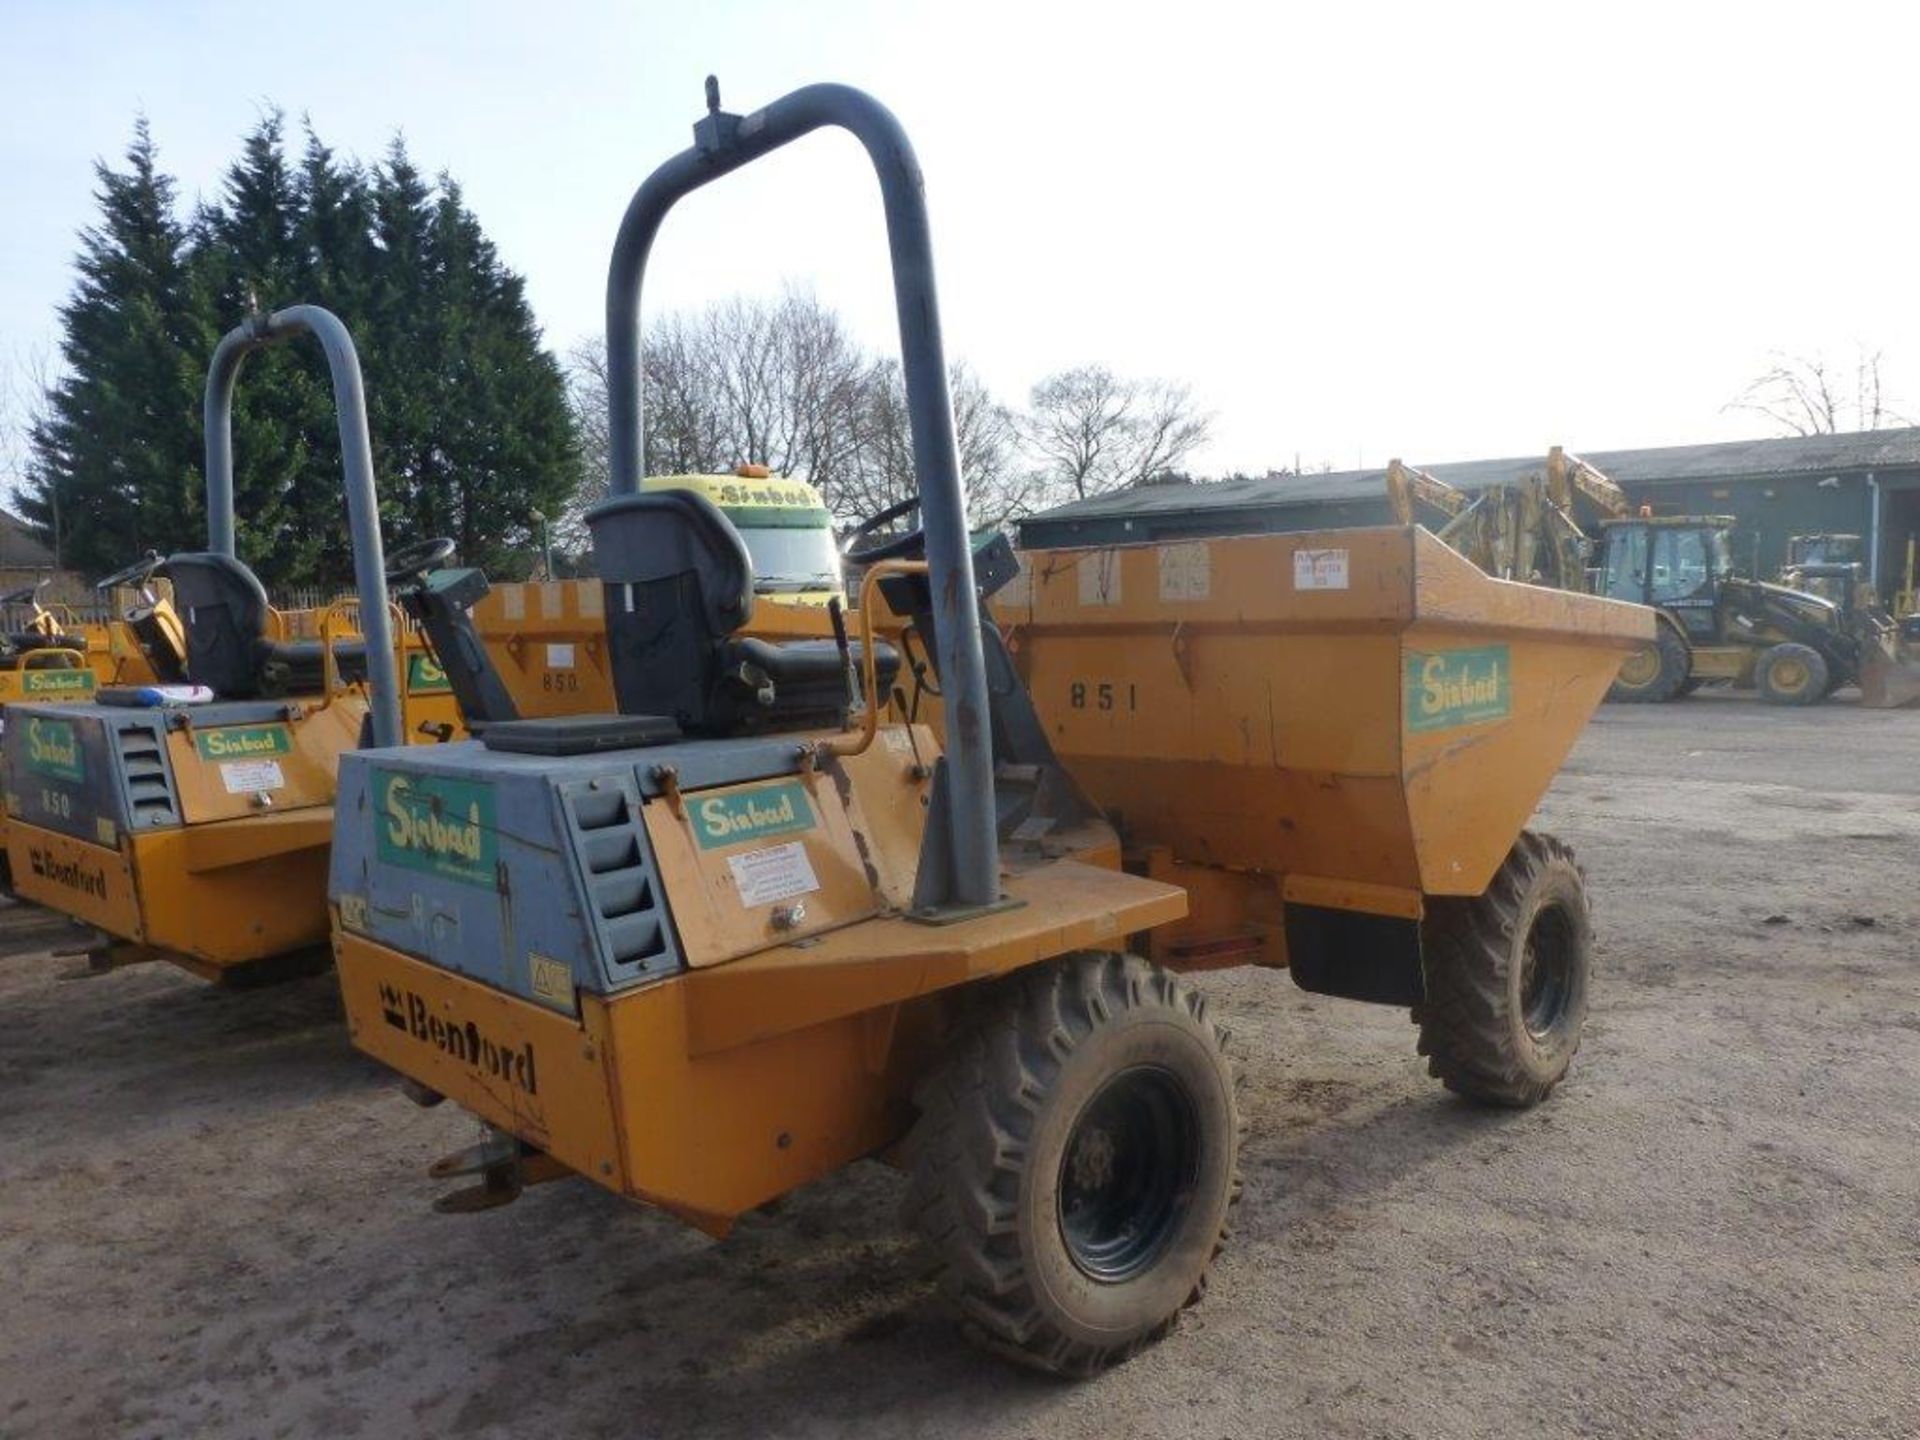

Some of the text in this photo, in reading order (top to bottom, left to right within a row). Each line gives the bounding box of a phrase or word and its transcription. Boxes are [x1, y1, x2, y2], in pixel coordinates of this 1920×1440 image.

[543, 673, 577, 692] 850
[1071, 682, 1135, 711] 851
[1422, 655, 1497, 714] Sinbad
[30, 718, 76, 767] Sinbad
[207, 731, 275, 755] Sinbad
[387, 775, 481, 861] Sinbad
[701, 794, 794, 836] Sinbad
[406, 990, 537, 1096] Benford
